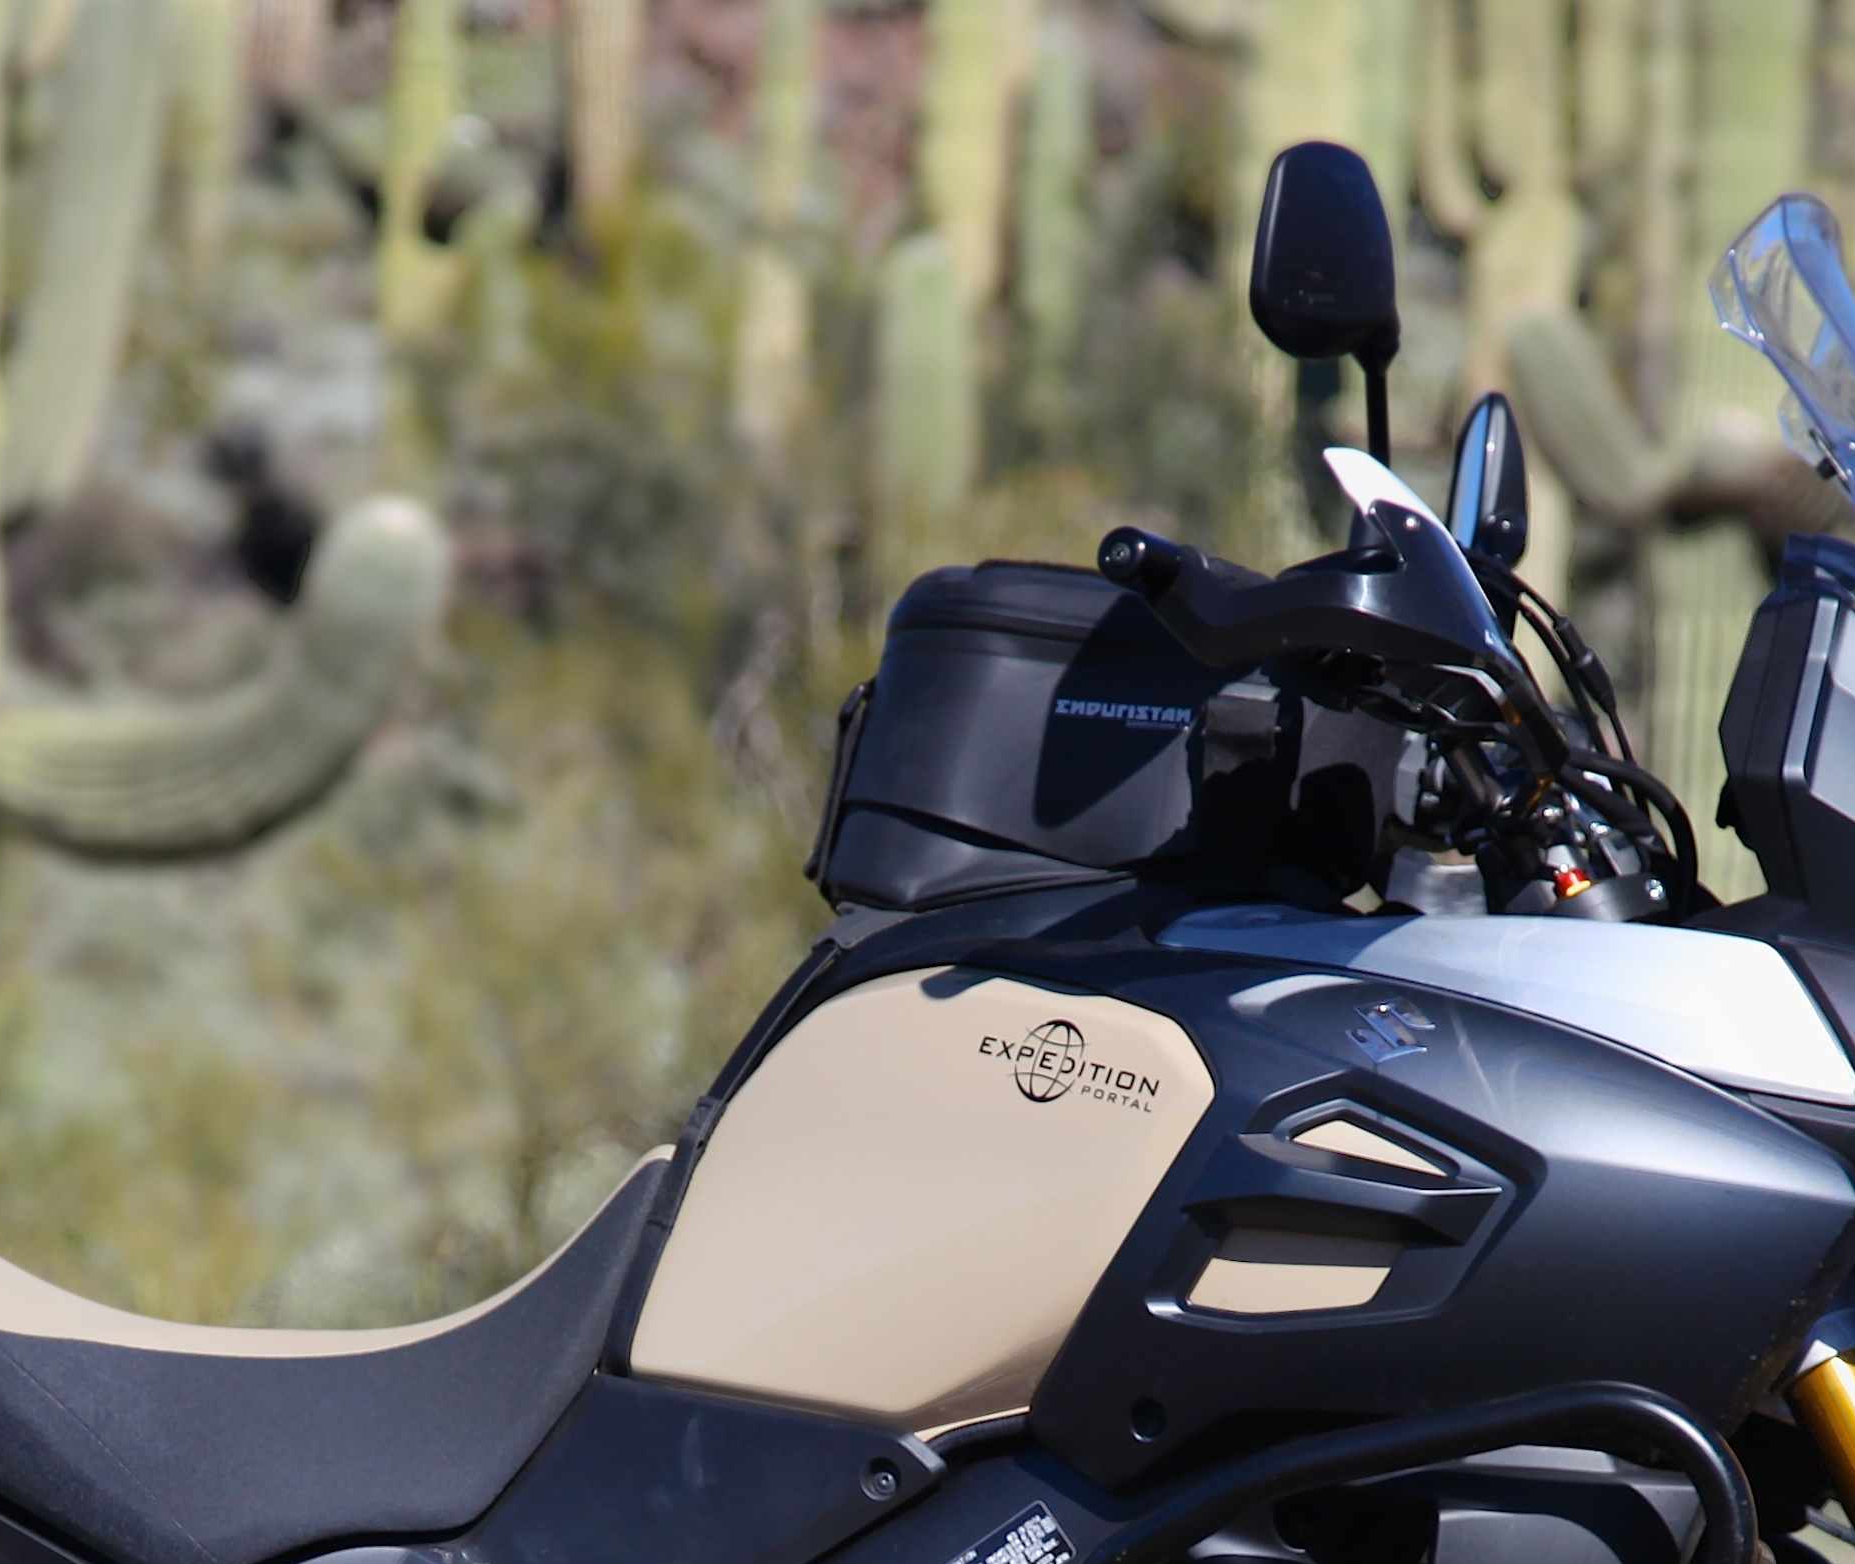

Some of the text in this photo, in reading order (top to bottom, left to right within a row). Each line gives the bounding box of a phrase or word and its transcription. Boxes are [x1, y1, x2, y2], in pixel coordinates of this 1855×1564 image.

[1055, 699, 1191, 722] ENDURISTAN
[978, 1036, 1161, 1097] EXPEDITION
[1081, 1085, 1153, 1113] PORTAL
